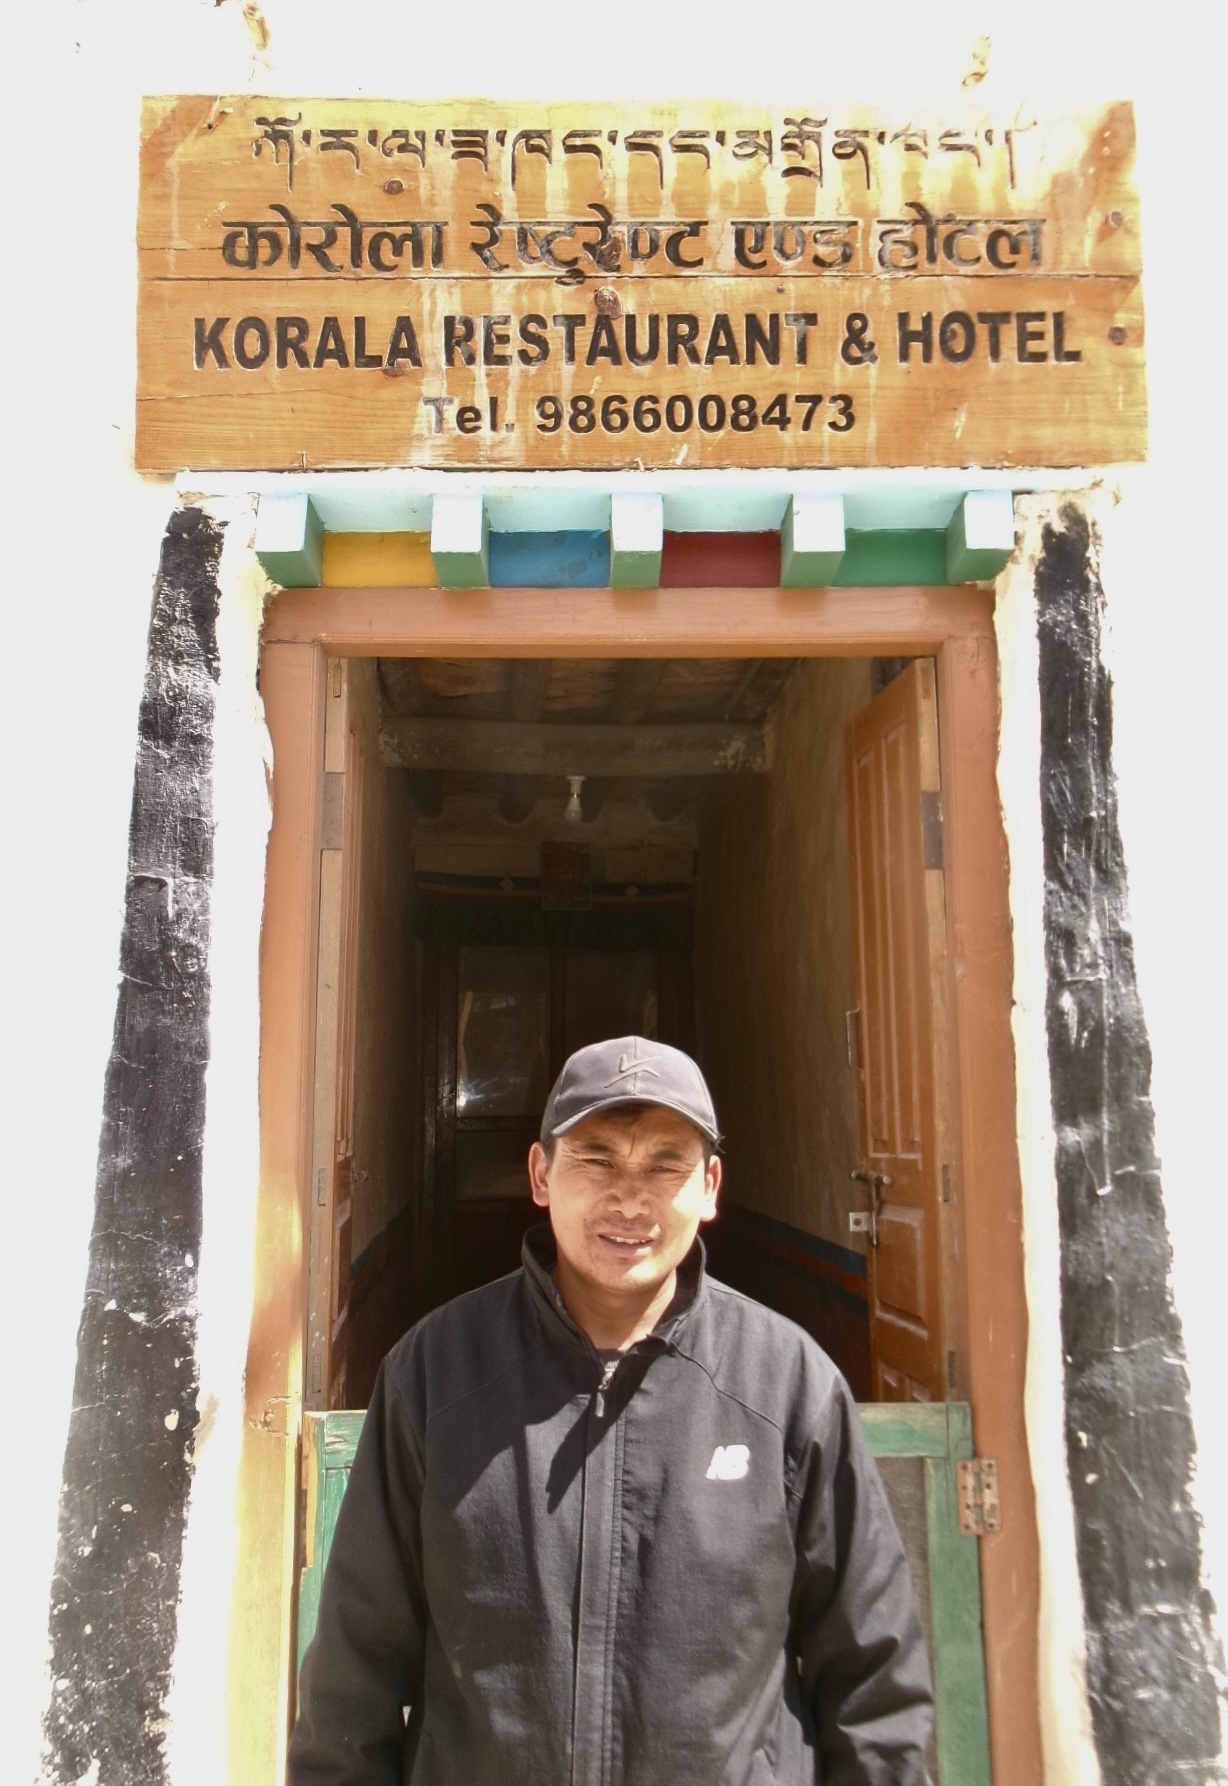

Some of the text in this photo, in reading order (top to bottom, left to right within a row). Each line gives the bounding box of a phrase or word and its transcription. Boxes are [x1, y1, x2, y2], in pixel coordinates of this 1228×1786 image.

[221, 203, 448, 273] कोरोला
[730, 220, 859, 270] एण्ड
[876, 201, 1047, 271] होटल
[193, 309, 1083, 371] KORALA RESTAURANT & HOTEL
[422, 393, 855, 434] Tel. 9866008473
